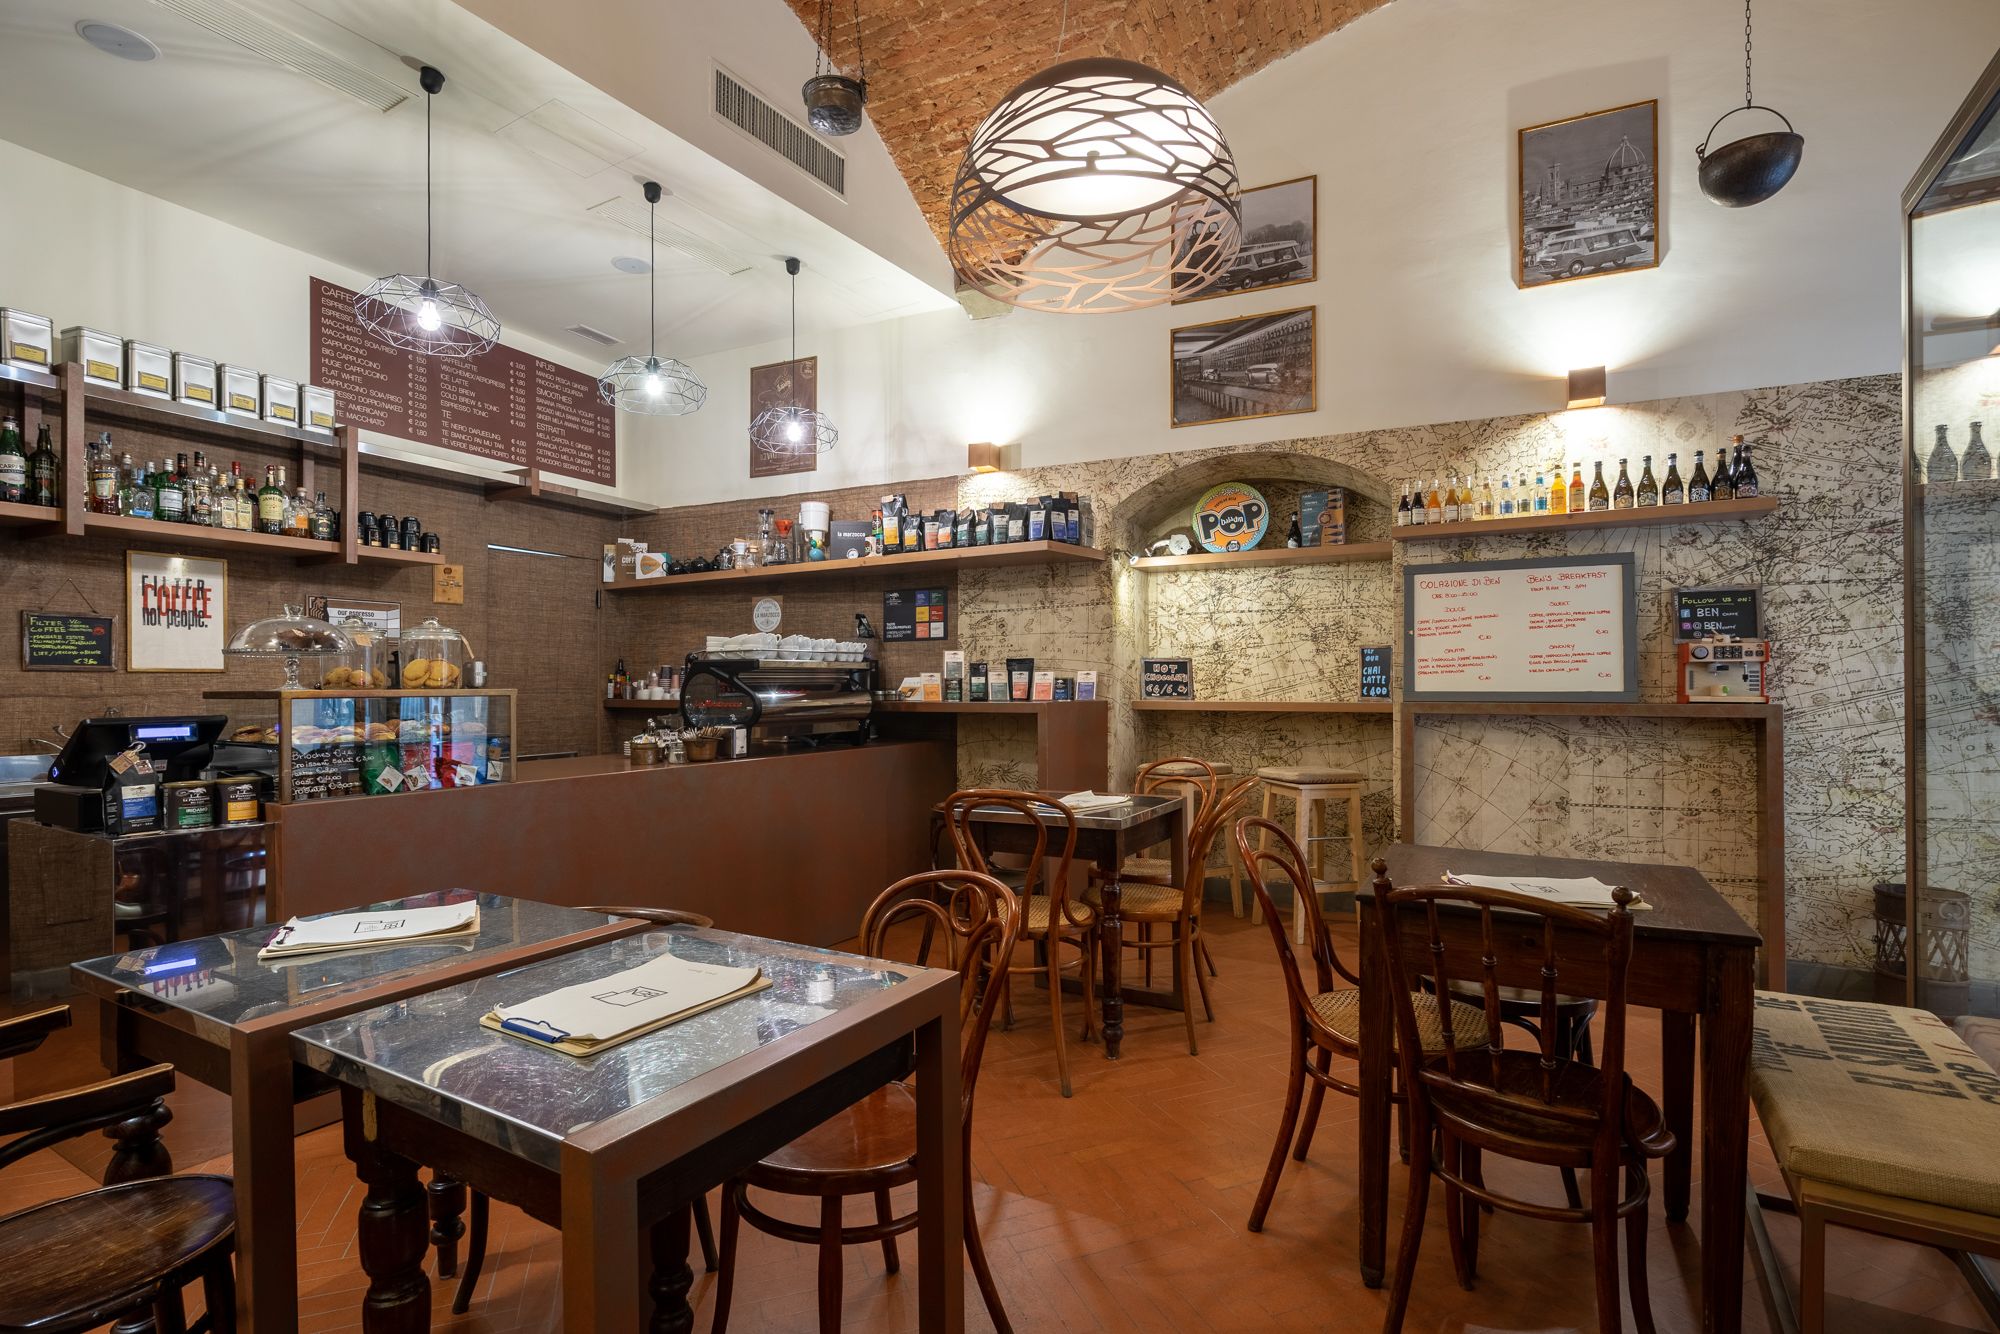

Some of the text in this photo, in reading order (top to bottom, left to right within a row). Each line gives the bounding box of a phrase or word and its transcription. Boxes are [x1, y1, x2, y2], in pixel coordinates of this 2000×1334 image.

[321, 307, 354, 323] ESPRESSO
[321, 317, 362, 335] MACCHIATO
[321, 327, 363, 345] MACCHIATO
[321, 338, 368, 356] CAPPUCCINO
[321, 348, 336, 358] BIG
[337, 352, 381, 370] CAPPUCCINO
[321, 357, 342, 369] HUGE
[344, 364, 388, 381] CAPPUCCINO
[321, 367, 338, 378] FLAT
[341, 371, 363, 384] WHITE
[321, 376, 368, 395] CAPPUCCINO
[441, 382, 457, 392] COLD
[458, 388, 476, 398] BREW
[441, 391, 457, 401] COLD
[346, 411, 386, 427] MACCHIATO
[348, 403, 388, 419] AMERICANO
[1196, 499, 1266, 544] POP
[142, 574, 205, 601] FILTER
[143, 583, 212, 619] COFFEE
[142, 607, 208, 631] not people.
[348, 610, 375, 618] espresso
[1696, 607, 1719, 617] BEN
[1152, 663, 1178, 674] HOT
[1362, 665, 1381, 675] CHAI
[1362, 675, 1386, 684] LATTE
